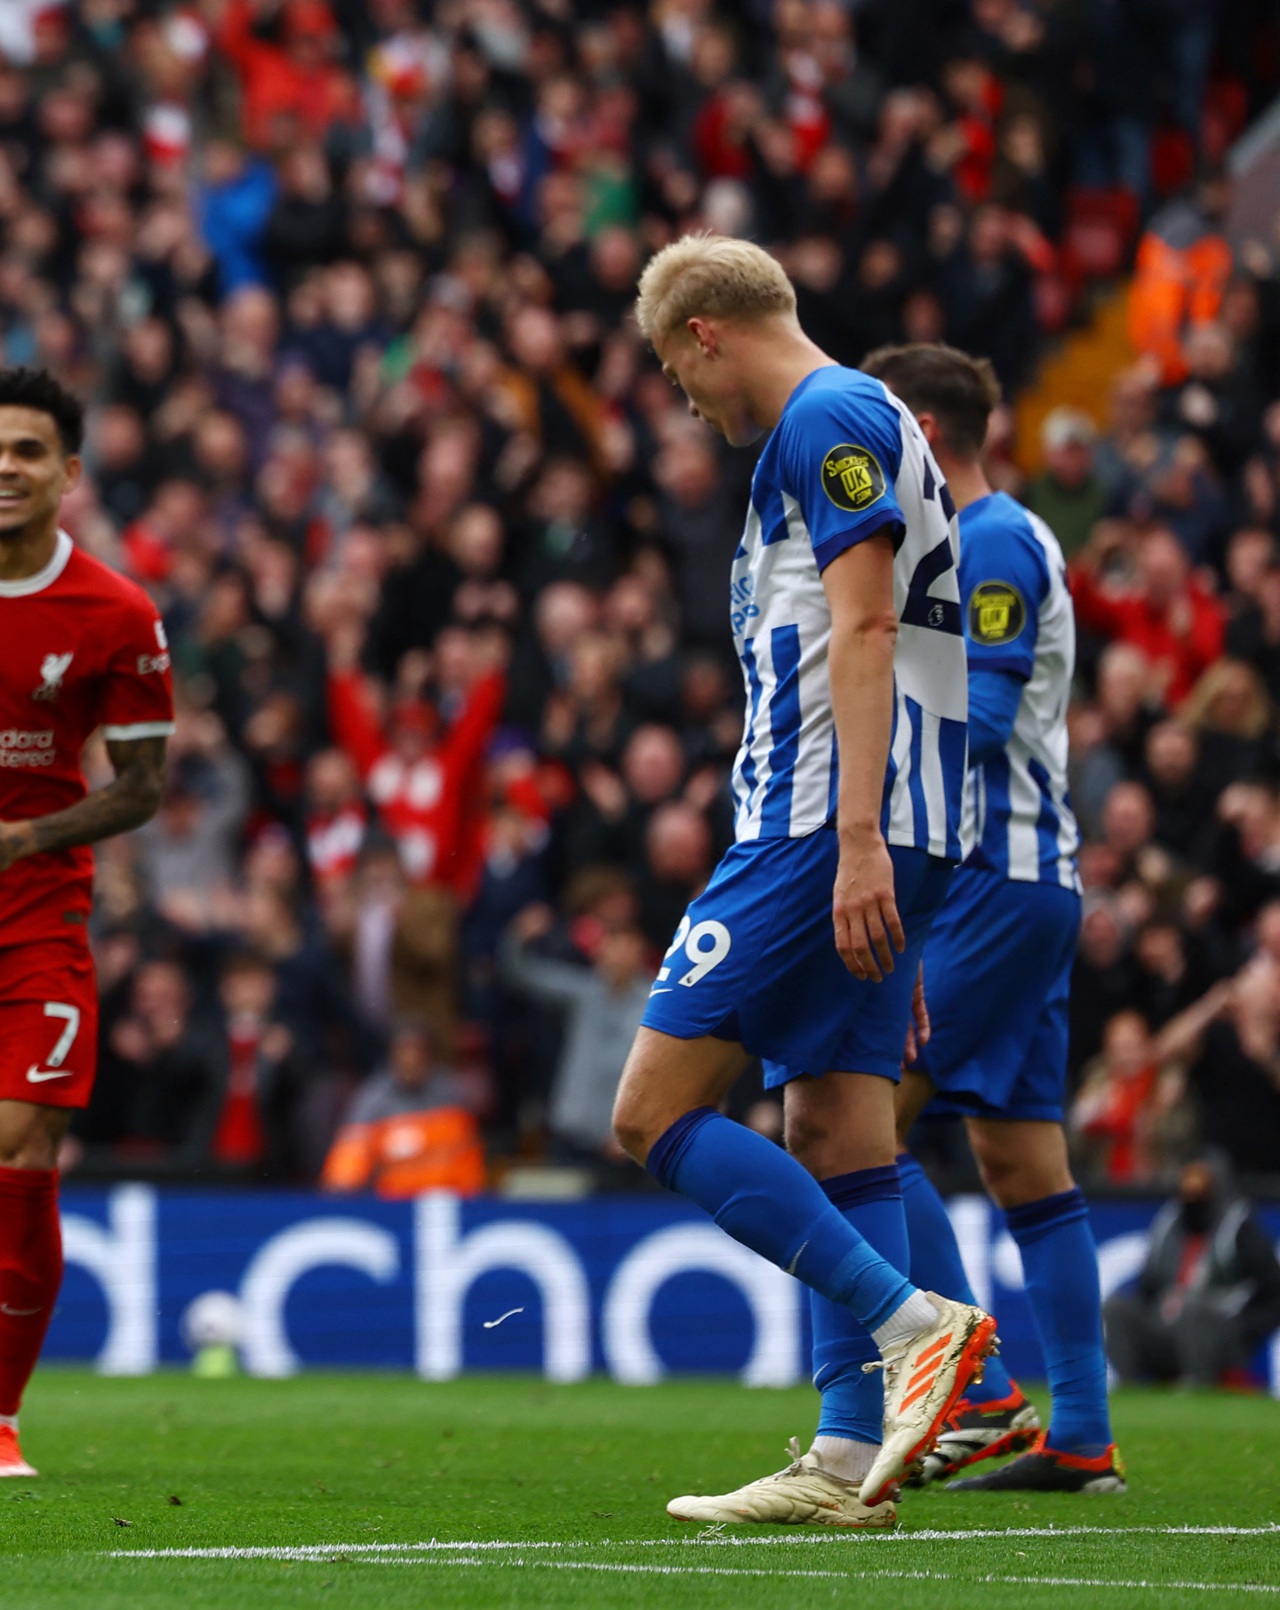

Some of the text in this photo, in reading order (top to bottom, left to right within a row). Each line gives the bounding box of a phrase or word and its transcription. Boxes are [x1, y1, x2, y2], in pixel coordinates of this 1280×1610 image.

[843, 467, 869, 493] UK
[657, 915, 732, 988] 29
[44, 1001, 80, 1067] 7
